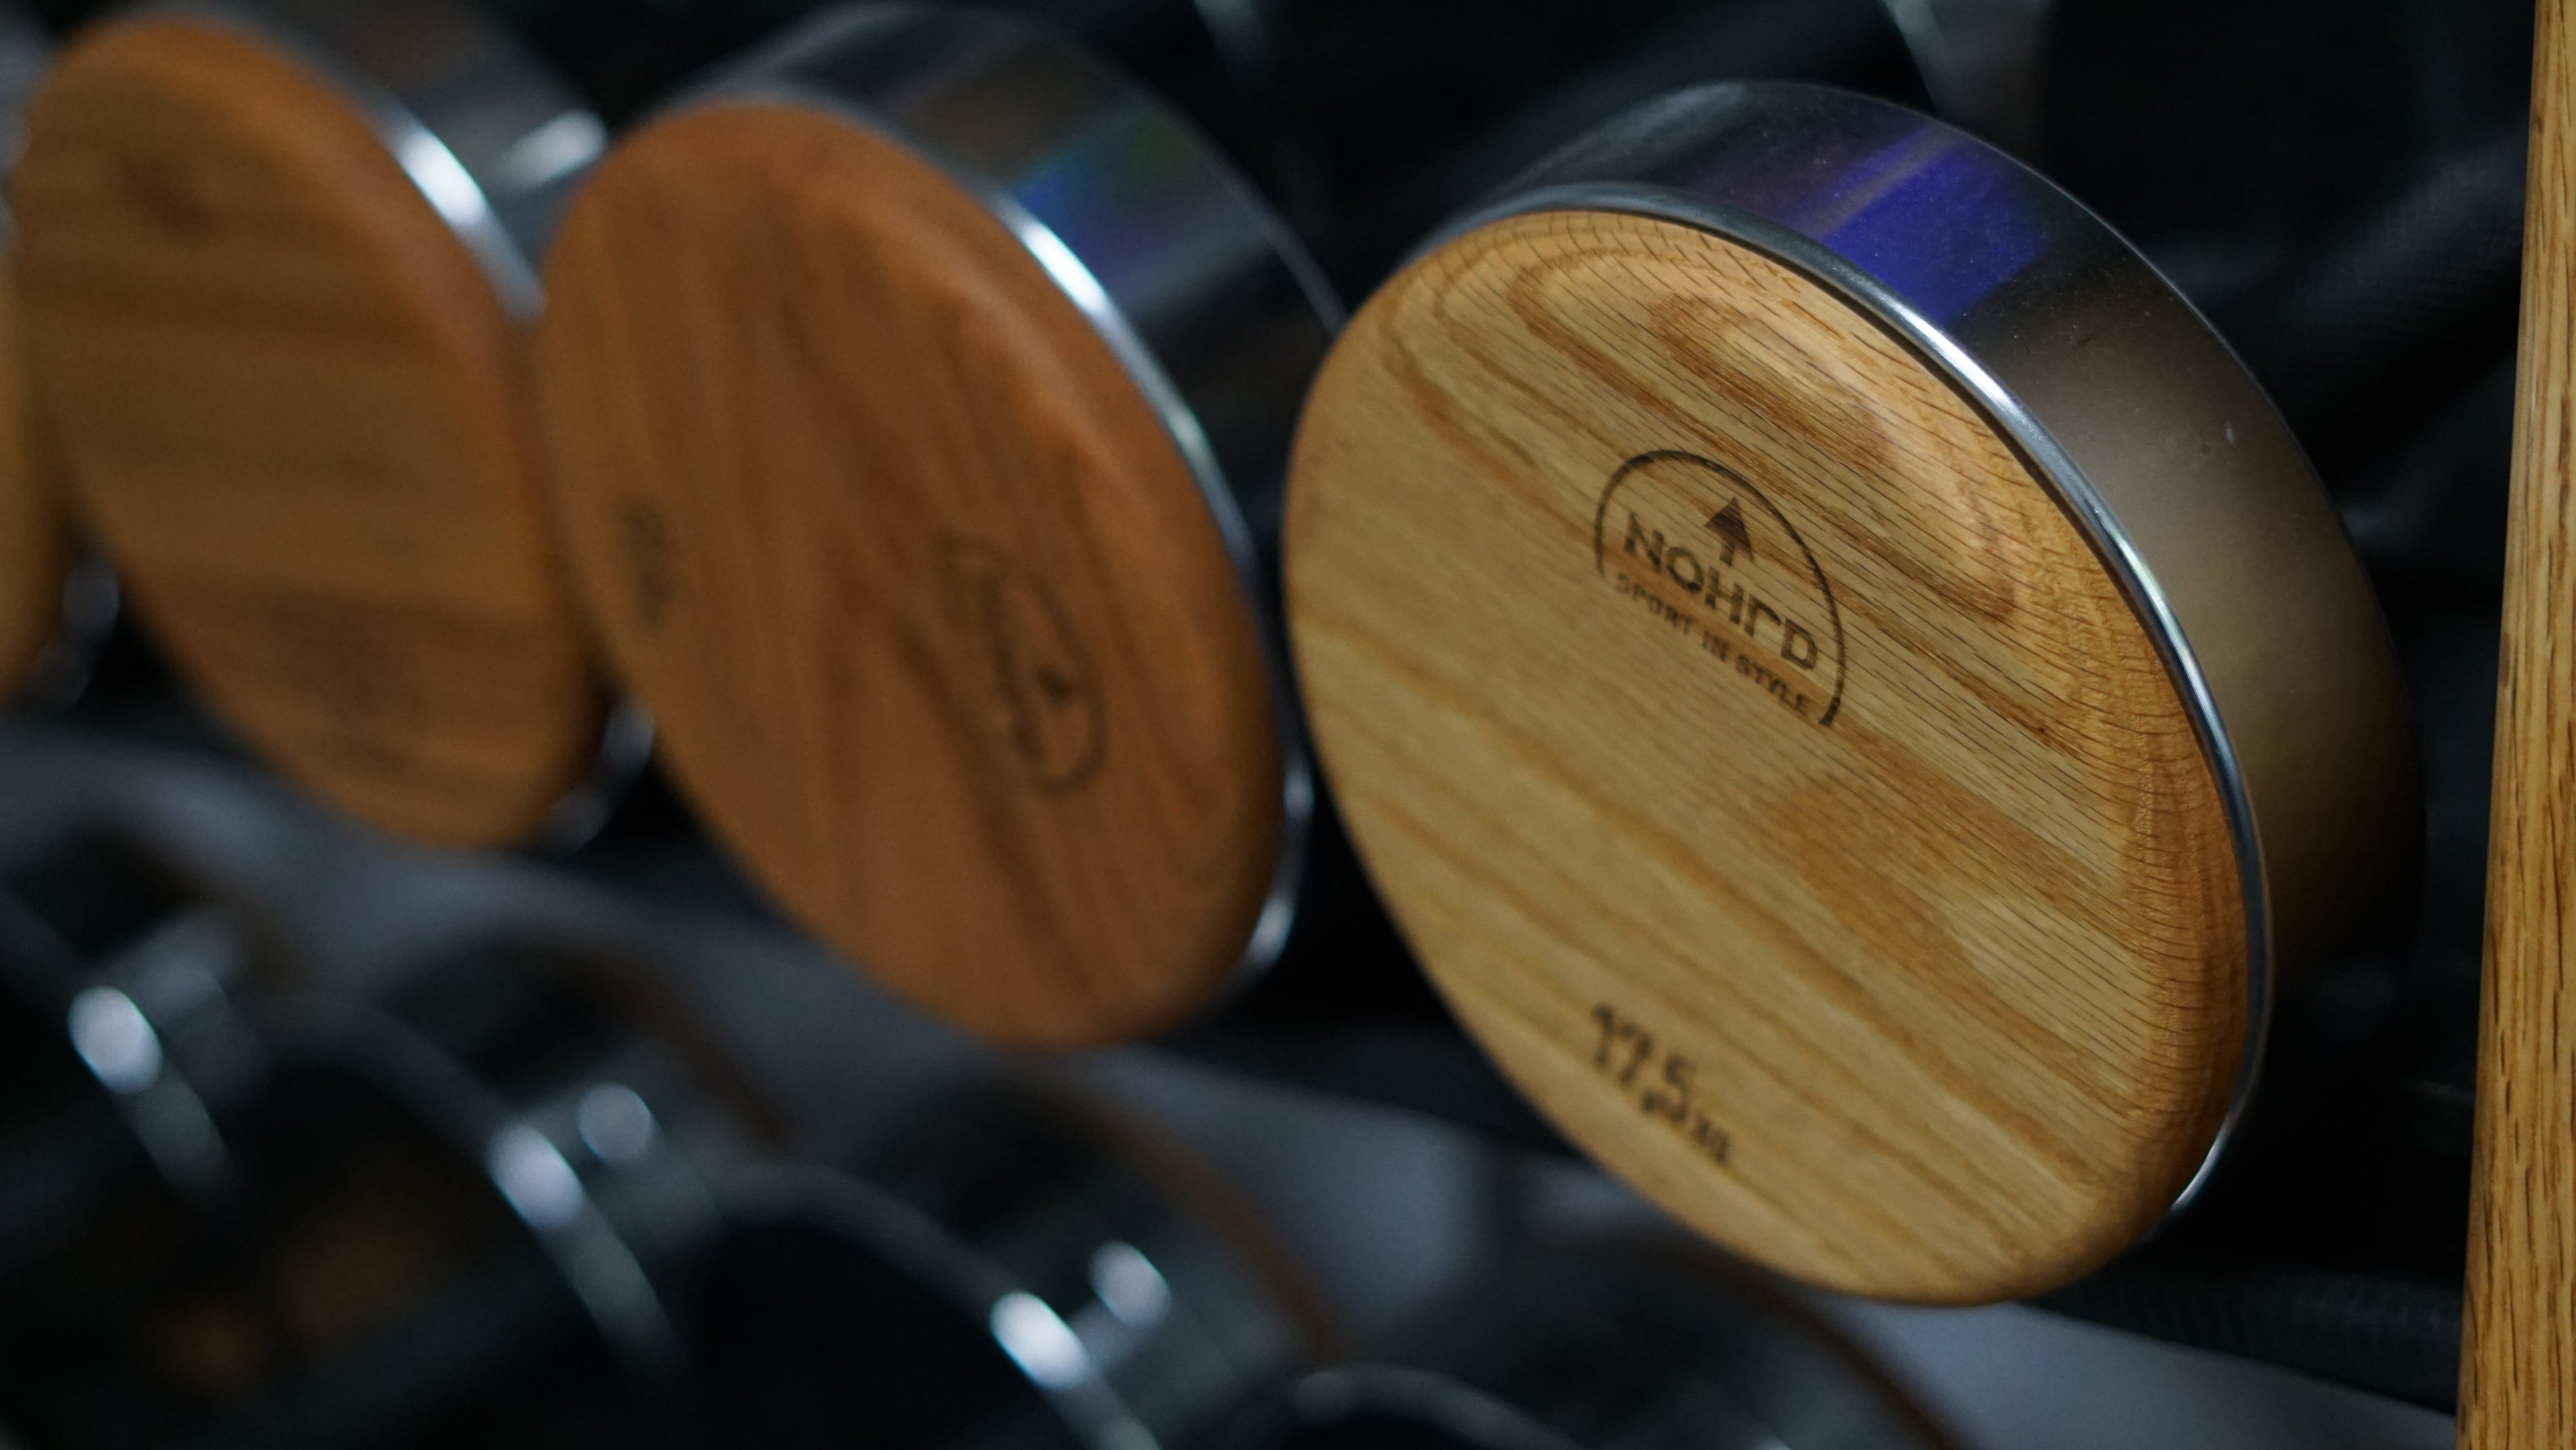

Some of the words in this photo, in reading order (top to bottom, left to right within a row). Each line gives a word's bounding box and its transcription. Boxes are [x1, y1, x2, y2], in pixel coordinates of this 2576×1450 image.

[1615, 572, 1693, 635] SPORT
[1703, 629, 1731, 663] IN
[1736, 654, 1811, 718] STYLE
